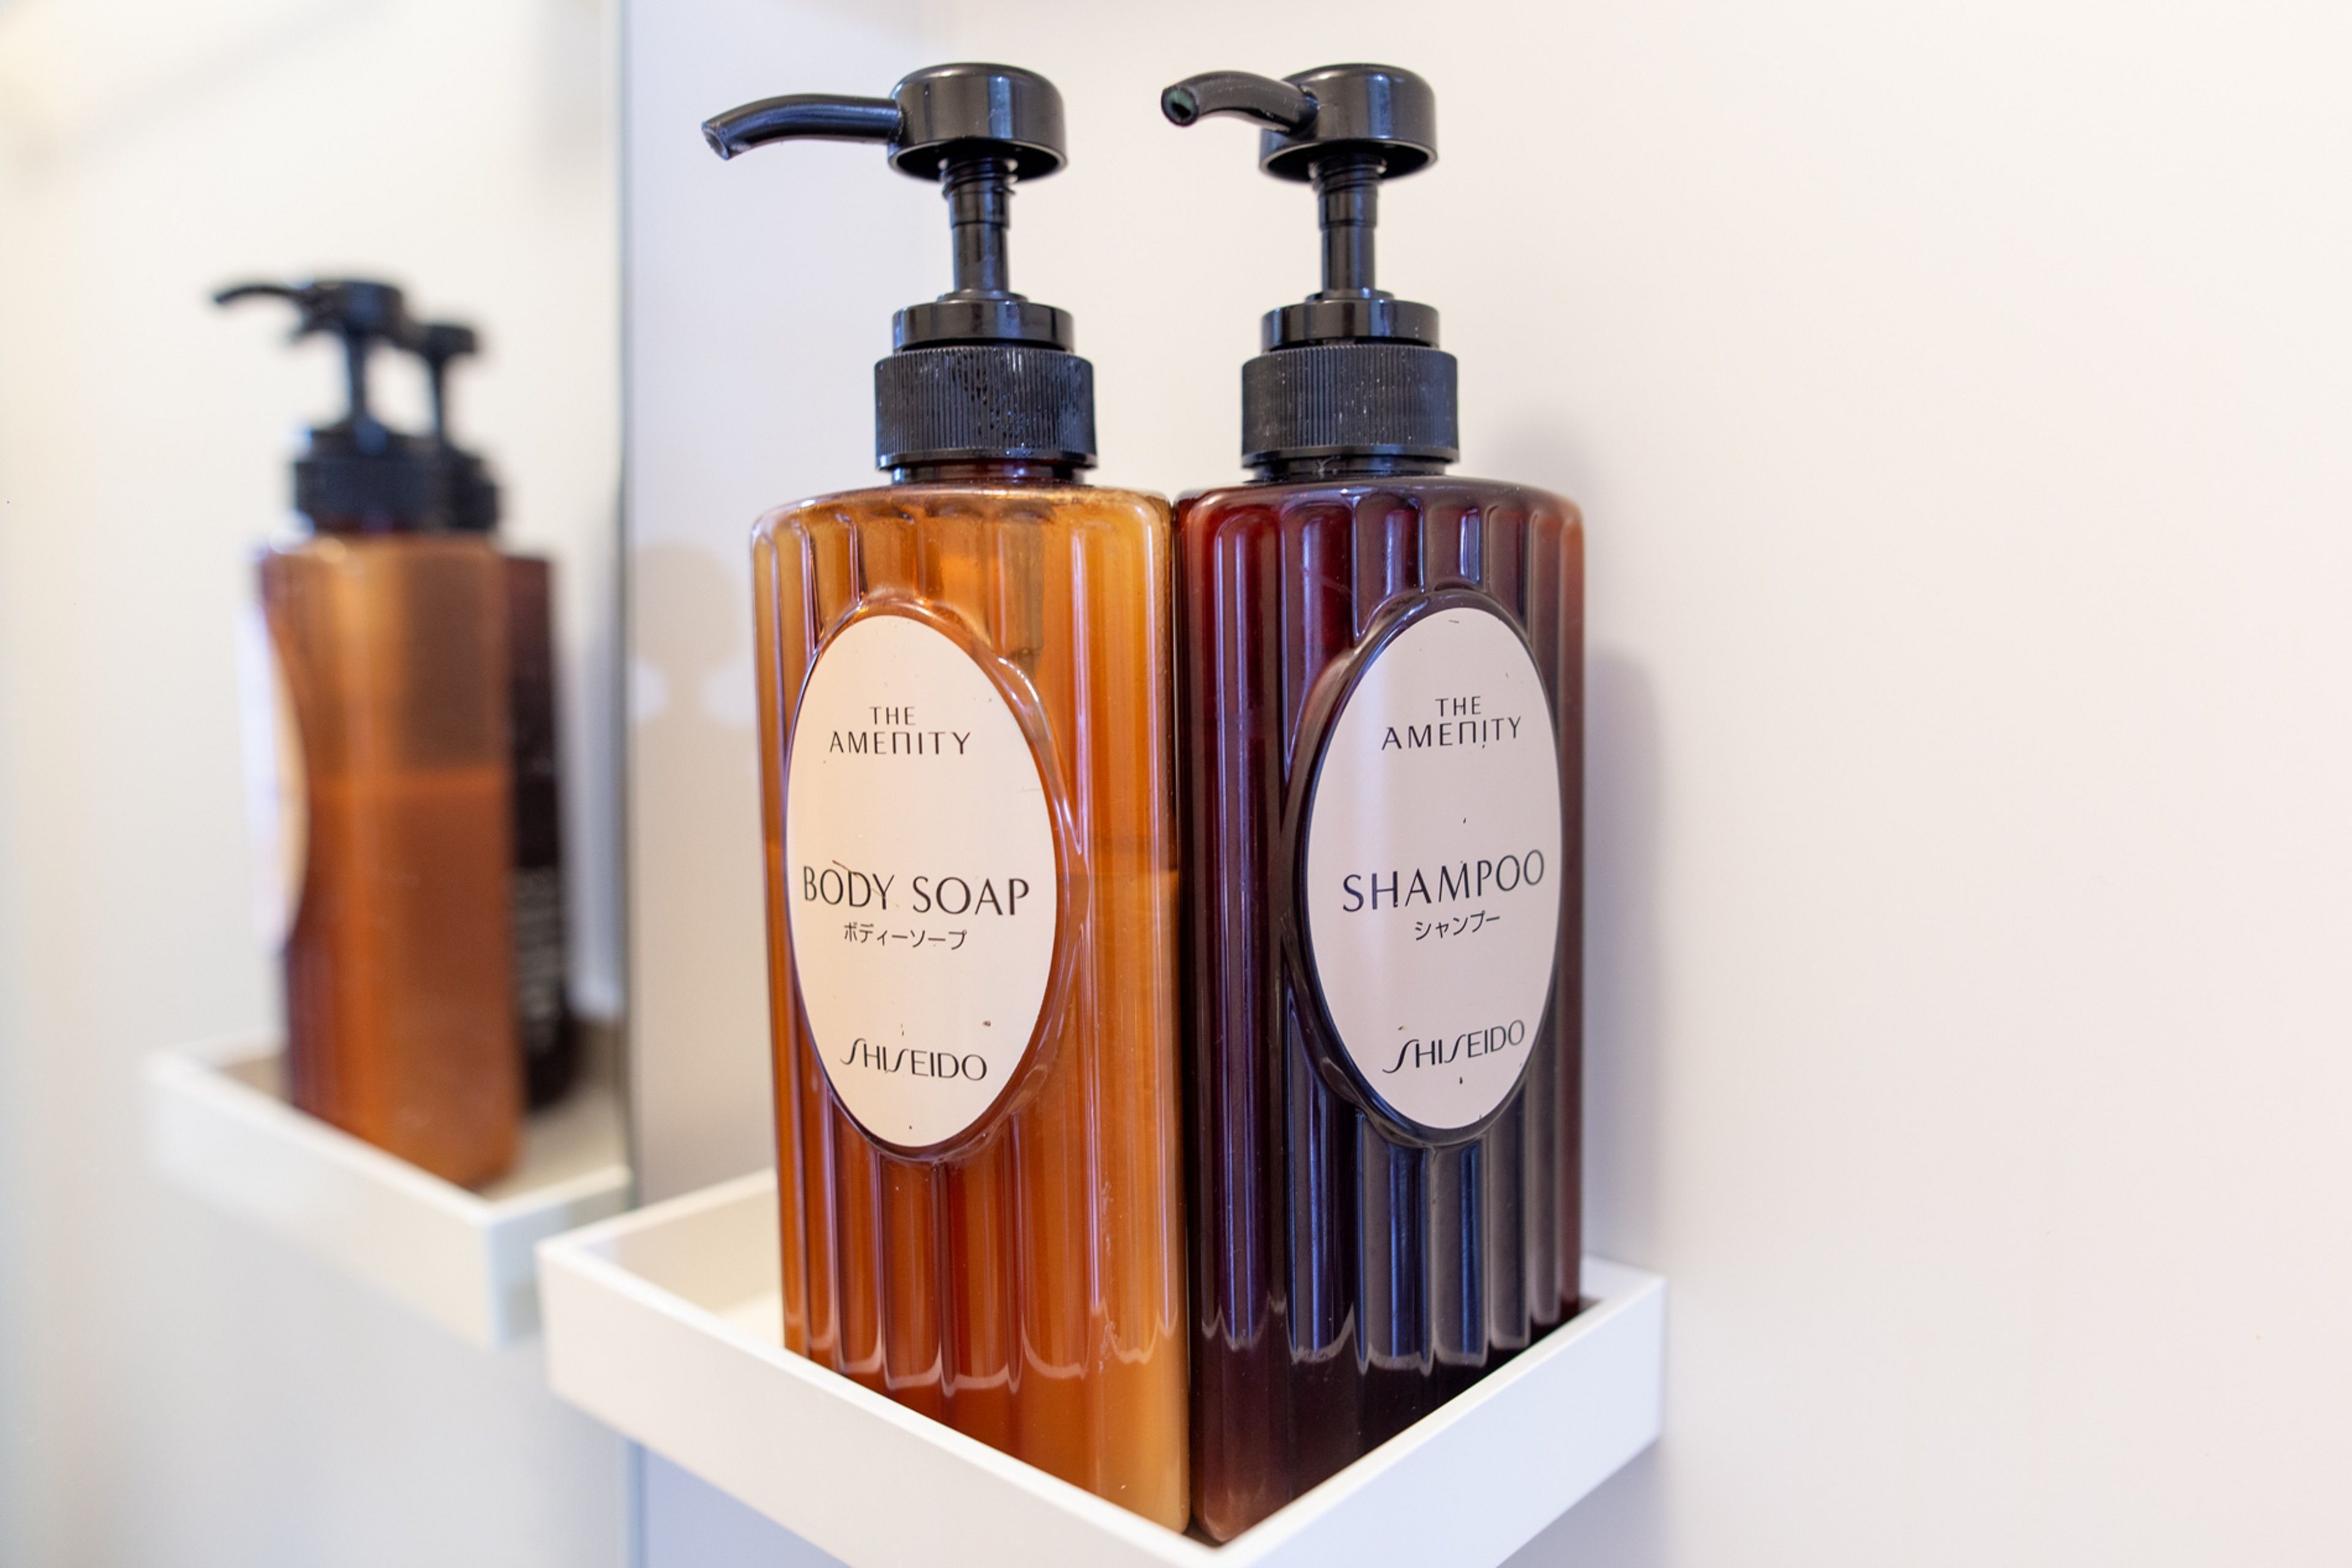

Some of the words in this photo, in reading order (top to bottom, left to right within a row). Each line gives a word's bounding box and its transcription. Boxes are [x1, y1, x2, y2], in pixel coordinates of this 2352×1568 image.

[869, 706, 916, 726] THE
[1435, 696, 1481, 716] THE
[804, 865, 895, 910] BODY
[912, 876, 1030, 916] SOAP
[1343, 849, 1545, 913] SHAMPOO
[844, 922, 968, 951] ボディーソープ
[1414, 910, 1500, 941] シャンプー
[840, 1038, 987, 1081] SHISEIDO
[1382, 1019, 1526, 1074] SHISEIDO
